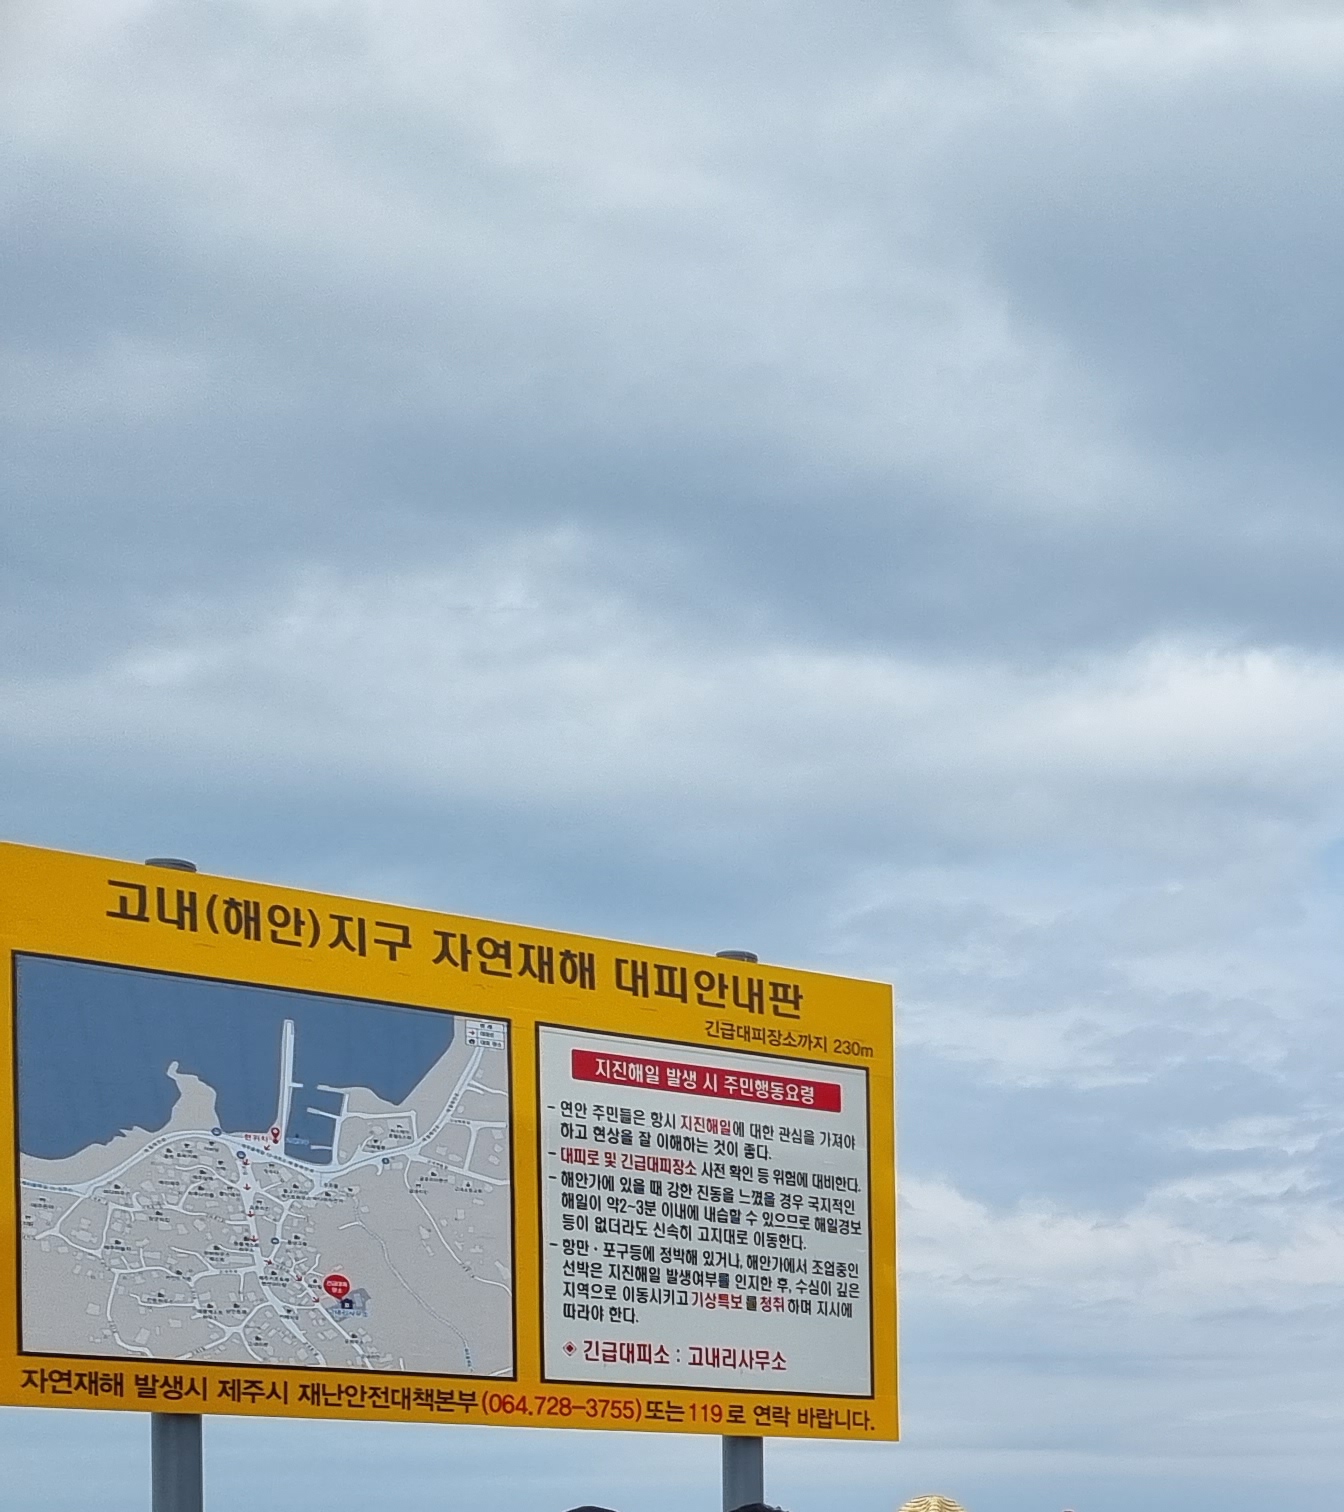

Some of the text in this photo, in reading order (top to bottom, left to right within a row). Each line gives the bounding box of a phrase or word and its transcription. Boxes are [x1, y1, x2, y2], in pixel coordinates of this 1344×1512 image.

[106, 879, 803, 1019] 고내(해안)지구 자연재해 대피안내판
[705, 1019, 874, 1058] 긴급대피장소까지 230m
[595, 1058, 814, 1105] 지진해일 발생 시 주민행동요령
[560, 1100, 856, 1150] 연안 주민들은 항시 지진해일에 대한 관심을 가져야
[560, 1122, 588, 1140] 하고
[593, 1125, 633, 1146] 현상을
[638, 1130, 651, 1147] 잘
[656, 1133, 708, 1154] 이해하는
[713, 1139, 738, 1158] 것이
[560, 1147, 861, 1193] 대피로 및 긴급대피장소 사전 확인 등 위험에 대비한다.
[561, 1170, 614, 1192] 해안가에
[619, 1176, 645, 1195] 있을
[650, 1179, 662, 1196] 때
[666, 1181, 692, 1200] 강한
[696, 1184, 735, 1204] 진동을
[779, 1192, 804, 1211] 경우
[808, 1195, 855, 1216] 국지적인
[561, 1192, 602, 1211] 해일이
[661, 1202, 699, 1221] 이내에
[704, 1206, 742, 1225] 내습할
[745, 1211, 758, 1226] 수
[762, 1212, 811, 1231] 있으므로
[814, 1216, 862, 1236] 해일경보
[562, 1213, 807, 1251] 등이 없더라도 신속히 고지대로 이동한다.
[562, 1238, 589, 1257] 항만
[602, 1241, 655, 1262] 포구등에
[660, 1246, 698, 1266] 정박해
[746, 1254, 808, 1275] 해안가에서
[811, 1259, 859, 1279] 조업중인
[562, 1259, 603, 1279] 선박은
[608, 1263, 661, 1283] 지진해일
[666, 1267, 730, 1289] 발생여부를
[735, 1273, 773, 1292] 인지한
[795, 1278, 832, 1296] 수심이
[836, 1281, 860, 1299] 깊은
[563, 1281, 618, 1301] 지역으로
[622, 1285, 688, 1306] 이동시키고
[760, 1296, 785, 1313] 청취
[787, 1298, 812, 1315] 하며
[816, 1301, 853, 1318] 지시에
[563, 1303, 639, 1324] 따라야 한다.
[583, 1340, 787, 1371] 긴급대피소 고내리사무소
[20, 1368, 124, 1398] 자연재해
[135, 1373, 208, 1402] 발생시
[217, 1378, 289, 1405] 제주시
[752, 1406, 791, 1428] 연락
[796, 1408, 876, 1431] 바랍니다.
